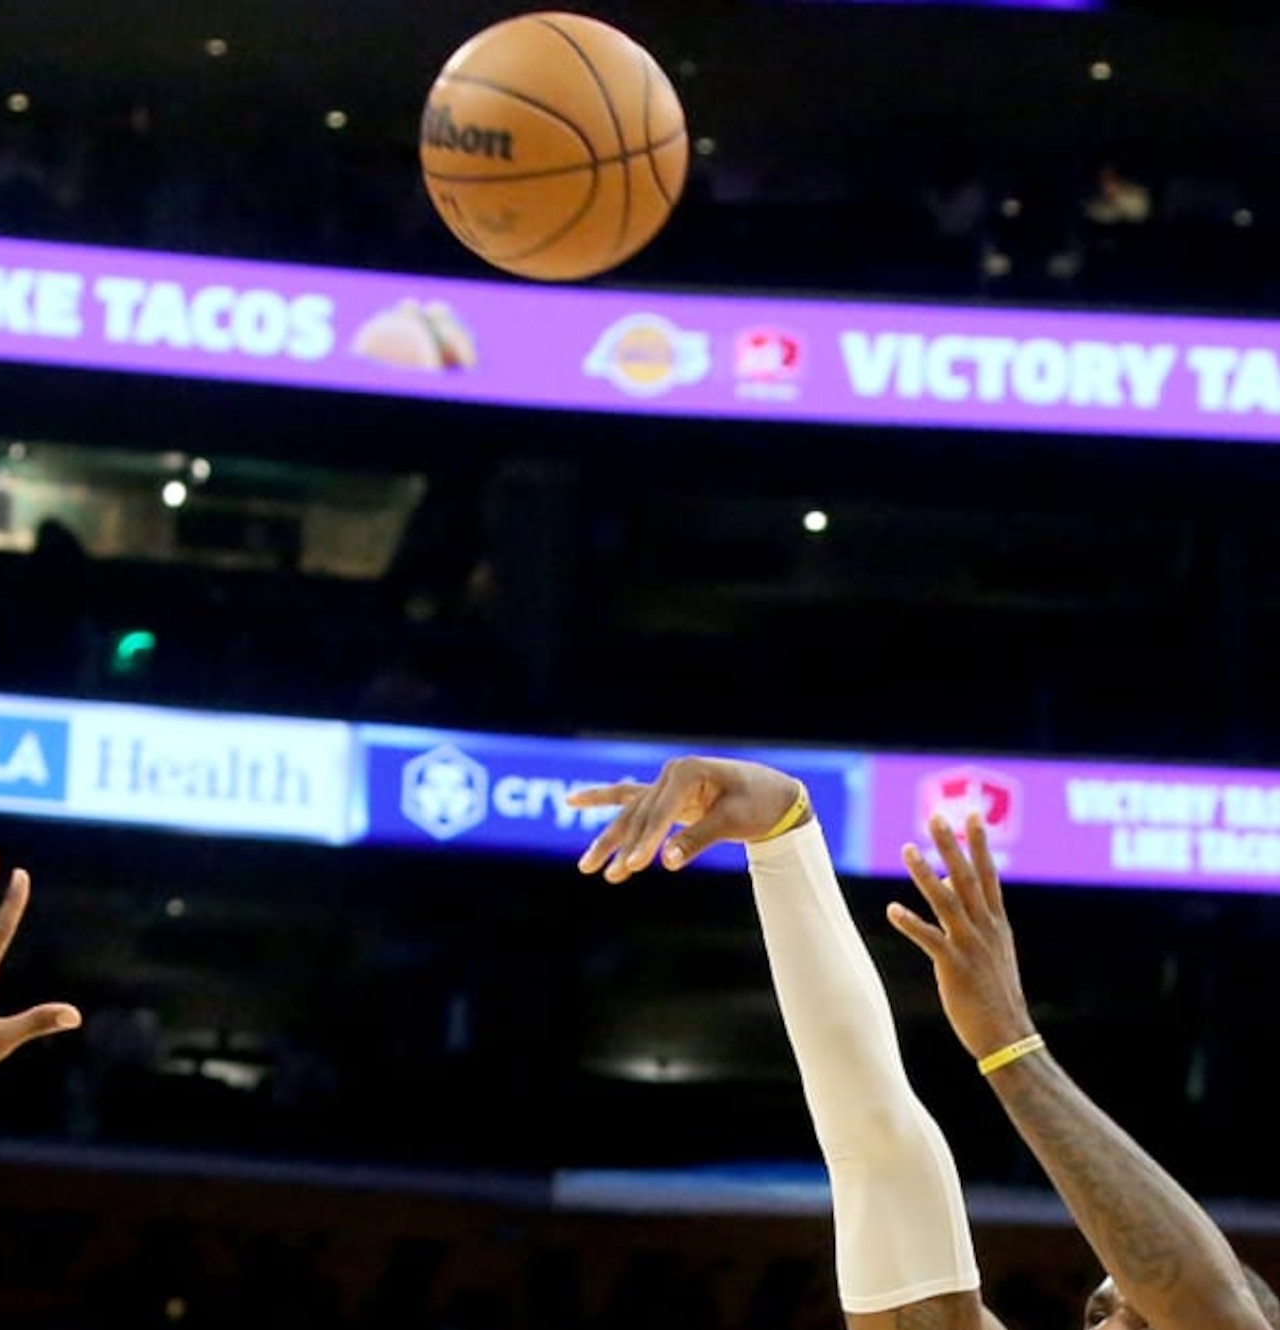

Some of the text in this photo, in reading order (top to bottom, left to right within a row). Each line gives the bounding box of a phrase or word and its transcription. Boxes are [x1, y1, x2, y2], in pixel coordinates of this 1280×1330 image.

[421, 103, 514, 161] ilson
[95, 276, 335, 361] TACOS
[839, 331, 1177, 410] VICTORY
[95, 736, 310, 807] Health
